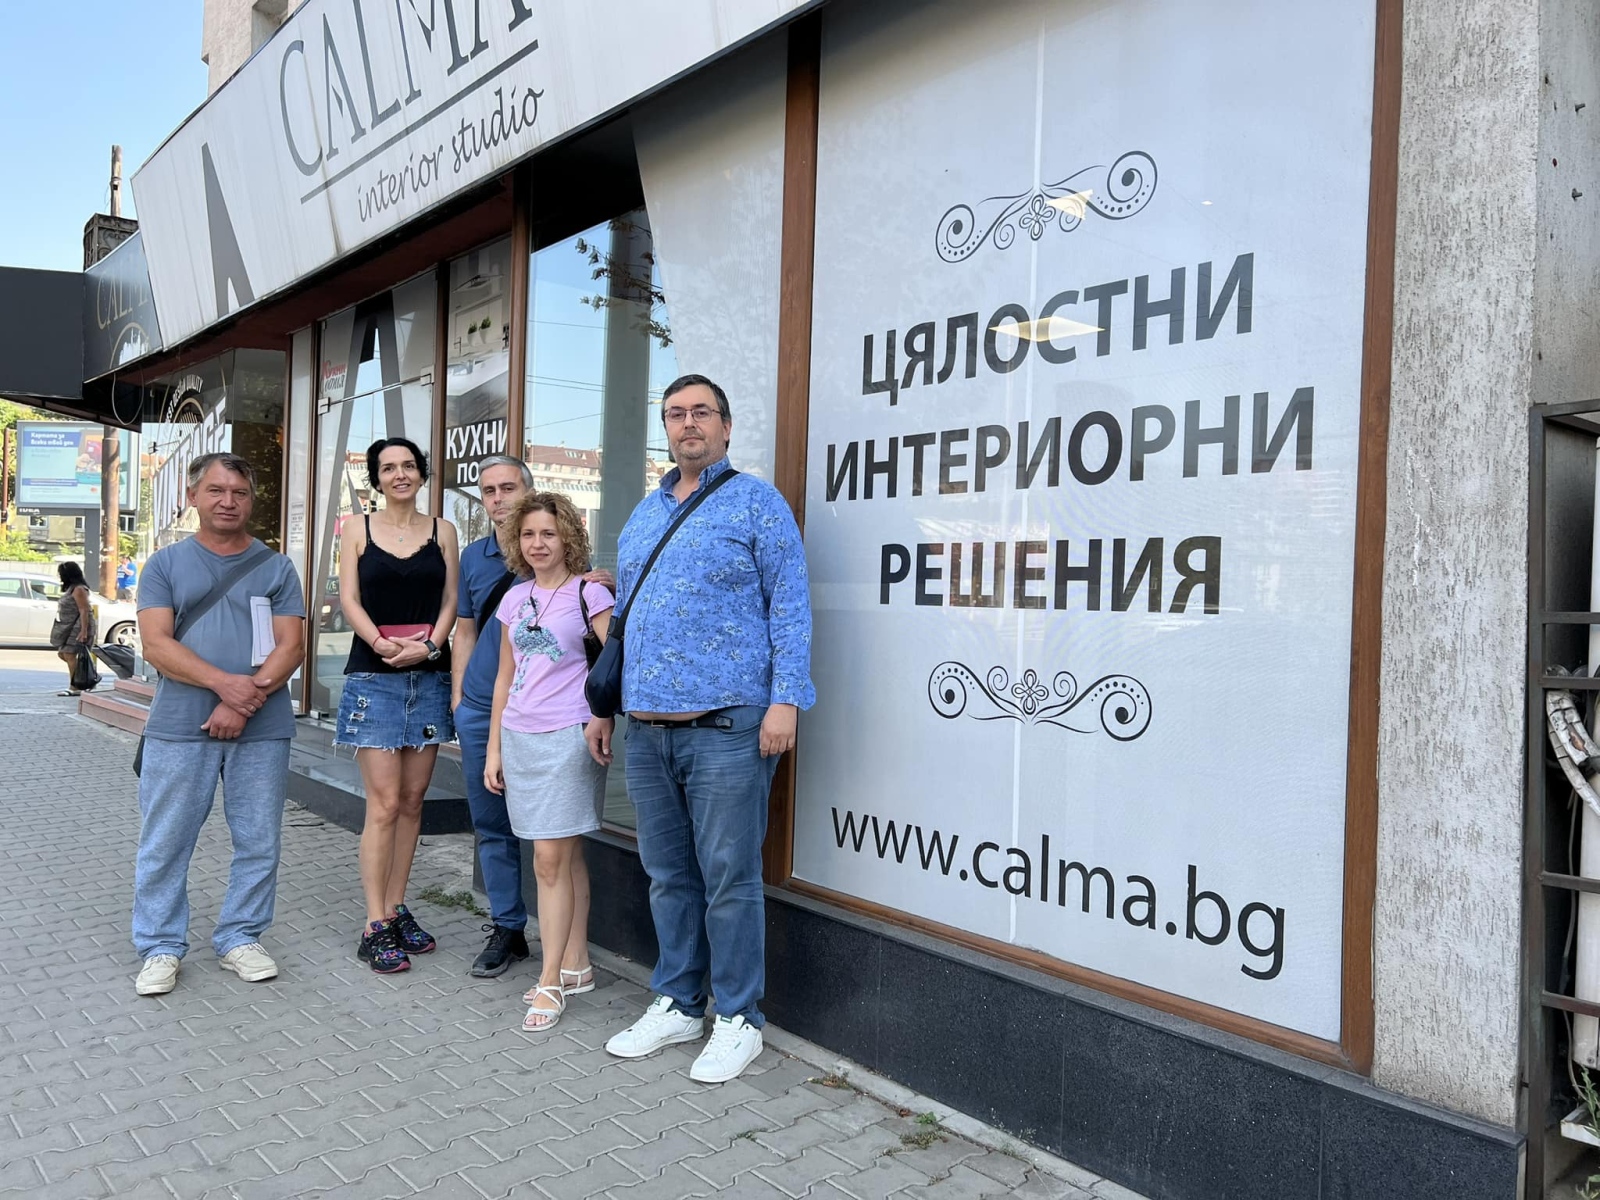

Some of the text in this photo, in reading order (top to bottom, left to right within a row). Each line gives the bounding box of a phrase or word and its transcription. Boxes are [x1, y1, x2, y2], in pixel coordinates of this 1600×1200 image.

[357, 86, 545, 223] interior studio
[861, 252, 1255, 406] ЦЯЛОСТНИ
[825, 386, 1315, 502] ИНТЕРИОРНИ
[880, 536, 1222, 615] РЕШЕНИЯ
[831, 807, 1286, 980] www.calma.bg
